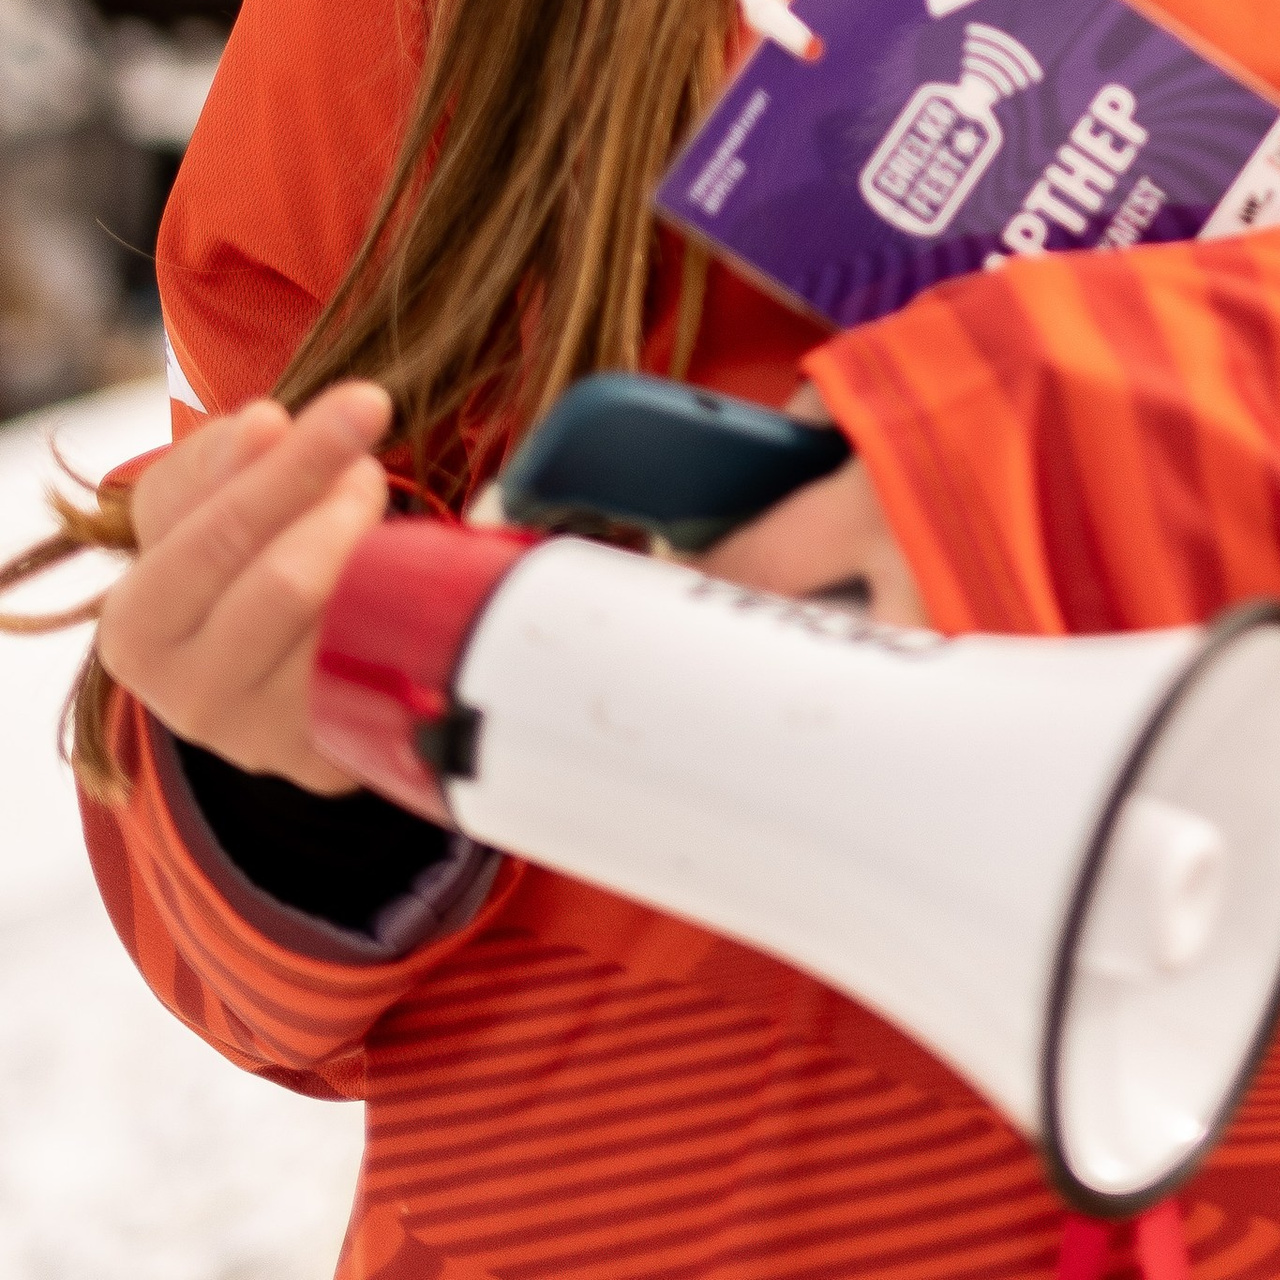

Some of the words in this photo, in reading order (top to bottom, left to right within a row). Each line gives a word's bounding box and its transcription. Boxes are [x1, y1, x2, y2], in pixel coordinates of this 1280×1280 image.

[878, 101, 957, 196] GRELKA
[907, 146, 966, 219] FEST
[986, 84, 1148, 269] РТНЕР
